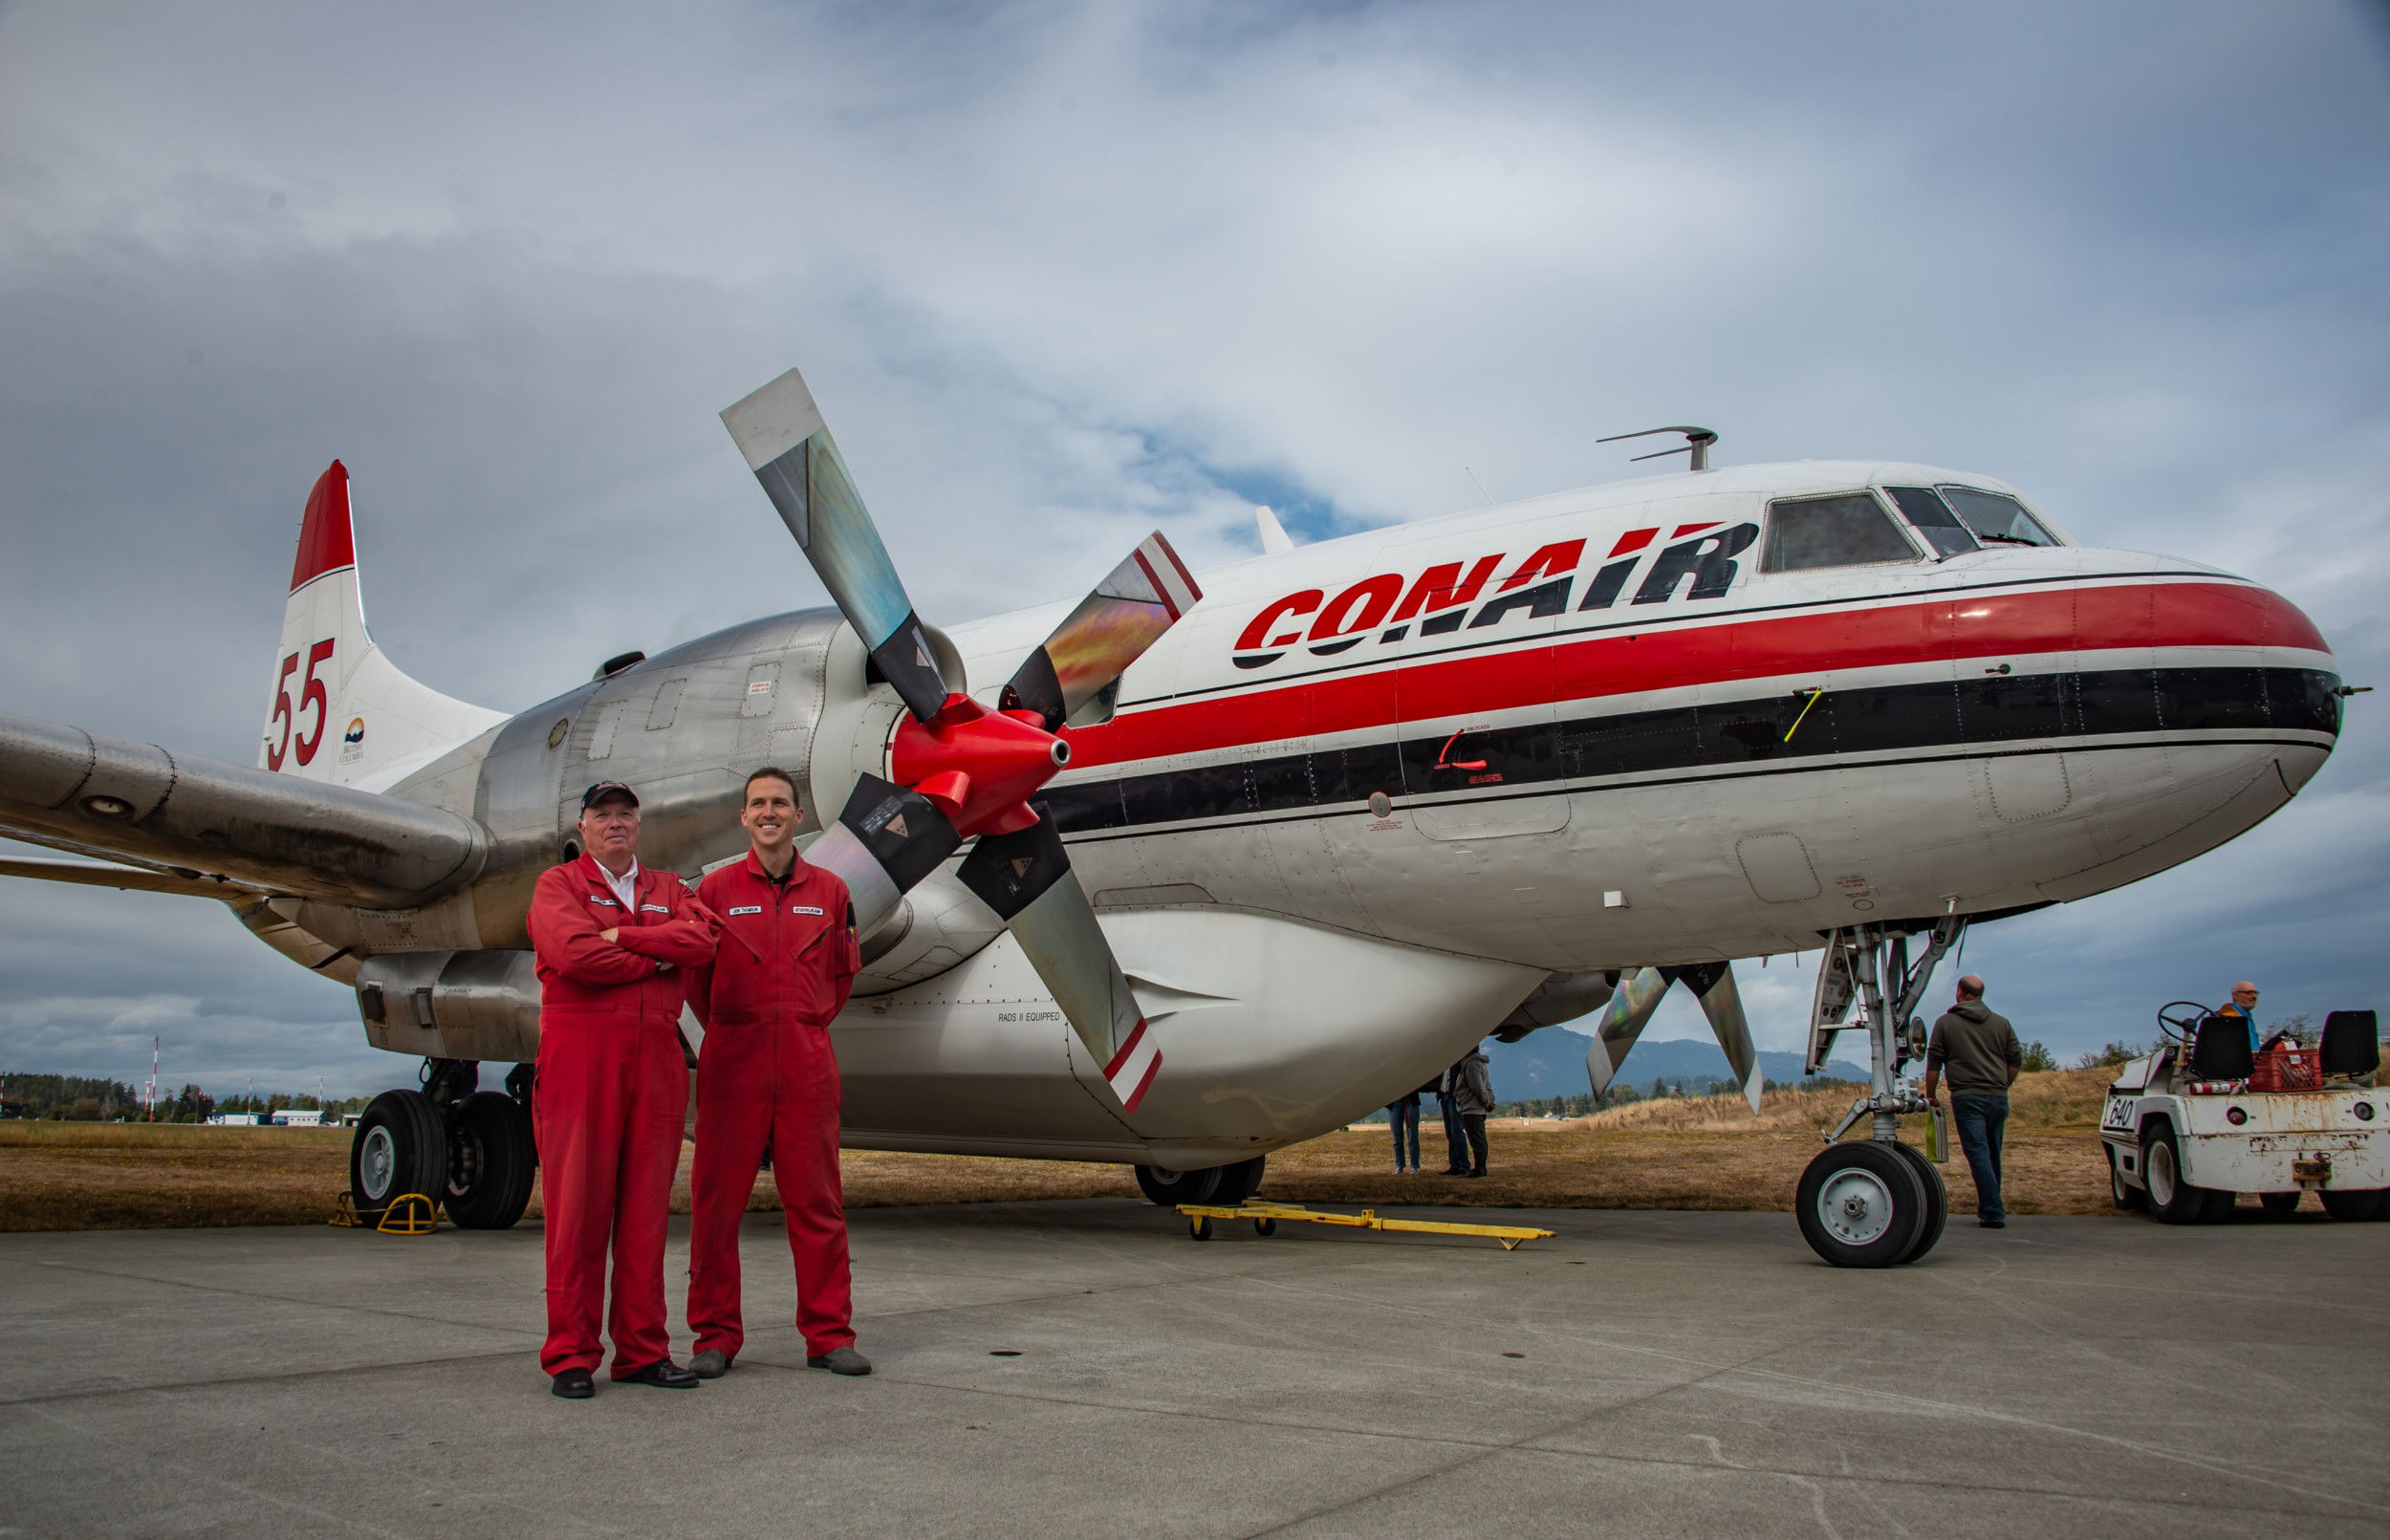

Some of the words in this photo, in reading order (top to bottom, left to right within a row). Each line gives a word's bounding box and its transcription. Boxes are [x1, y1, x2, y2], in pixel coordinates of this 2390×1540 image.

[1232, 521, 1760, 669] CONAIR
[268, 637, 335, 772] 55
[1466, 724, 1490, 732] UNLOCKED
[998, 1012, 1017, 1023] RADS
[1026, 1011, 1060, 1023] EQUIPPED
[2110, 1098, 2134, 1127] 640
